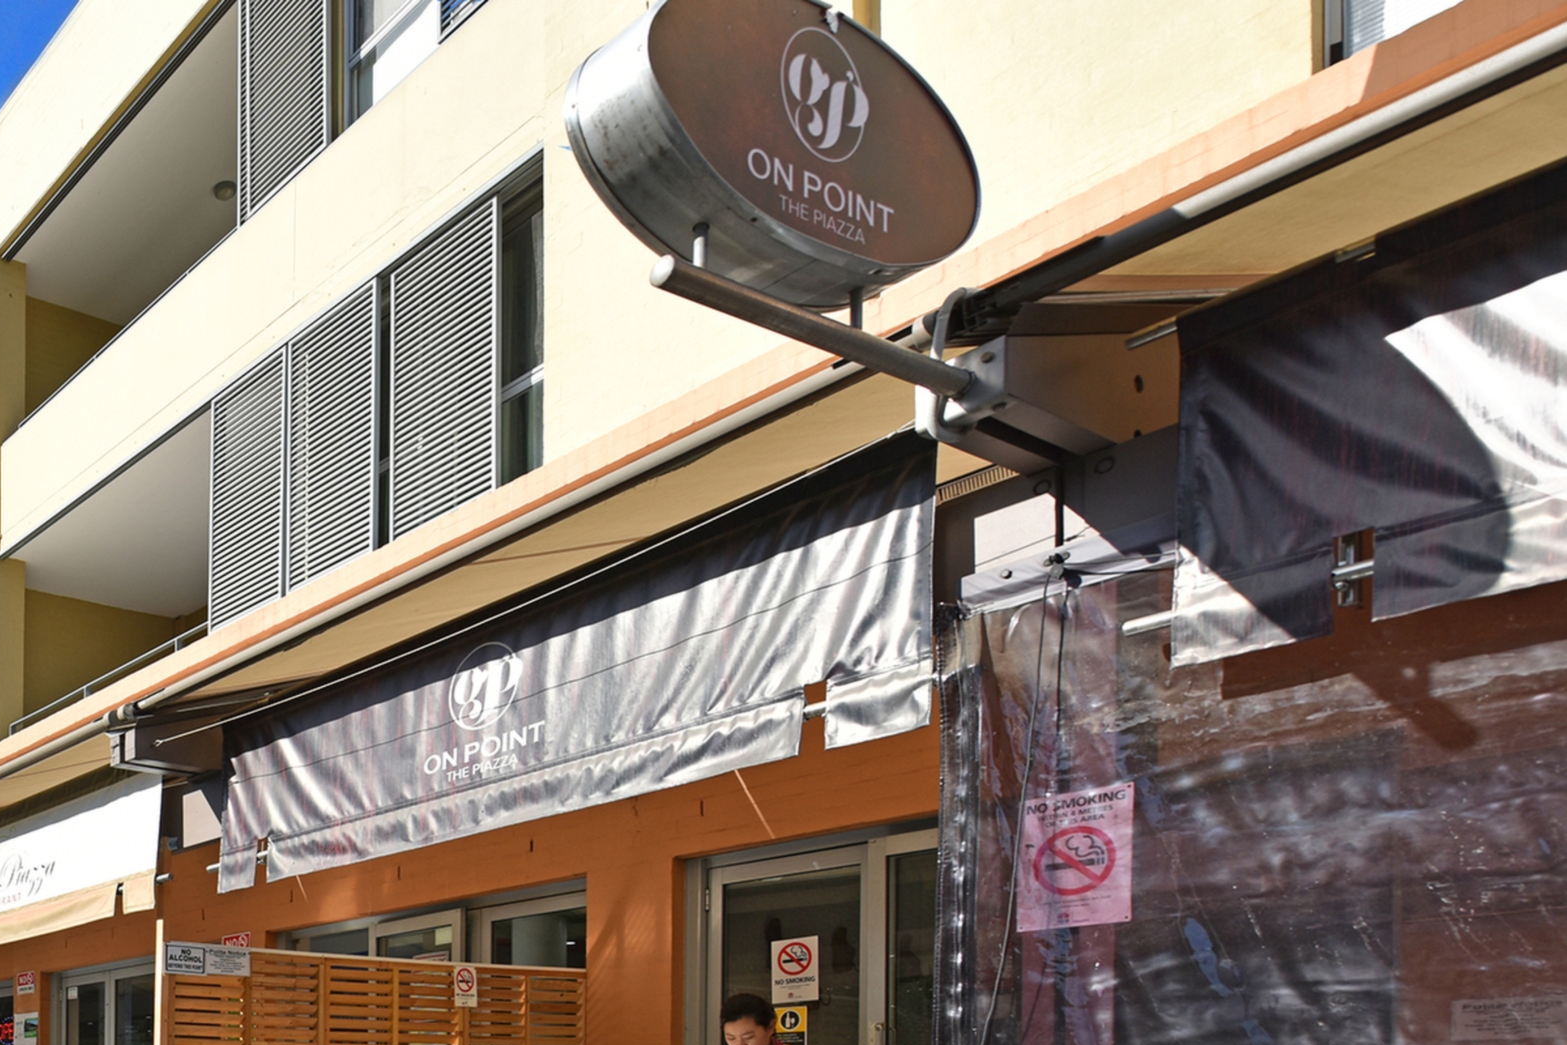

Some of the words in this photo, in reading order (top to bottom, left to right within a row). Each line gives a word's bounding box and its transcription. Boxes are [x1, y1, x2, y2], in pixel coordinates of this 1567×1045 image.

[747, 148, 793, 192] ON
[803, 170, 894, 233] POINT
[779, 194, 809, 221] THE
[813, 209, 866, 245] PIAZZA
[423, 748, 458, 775] ON
[463, 720, 545, 763] POINT
[446, 766, 469, 782] THE
[472, 753, 519, 776] PIAZZA
[1026, 803, 1048, 815] NO
[1053, 789, 1126, 811] SMOKING
[1080, 813, 1105, 822] AREA
[0, 853, 56, 898] Piazza
[169, 955, 202, 963] ALCOHOL
[785, 976, 816, 985] SMOKING
